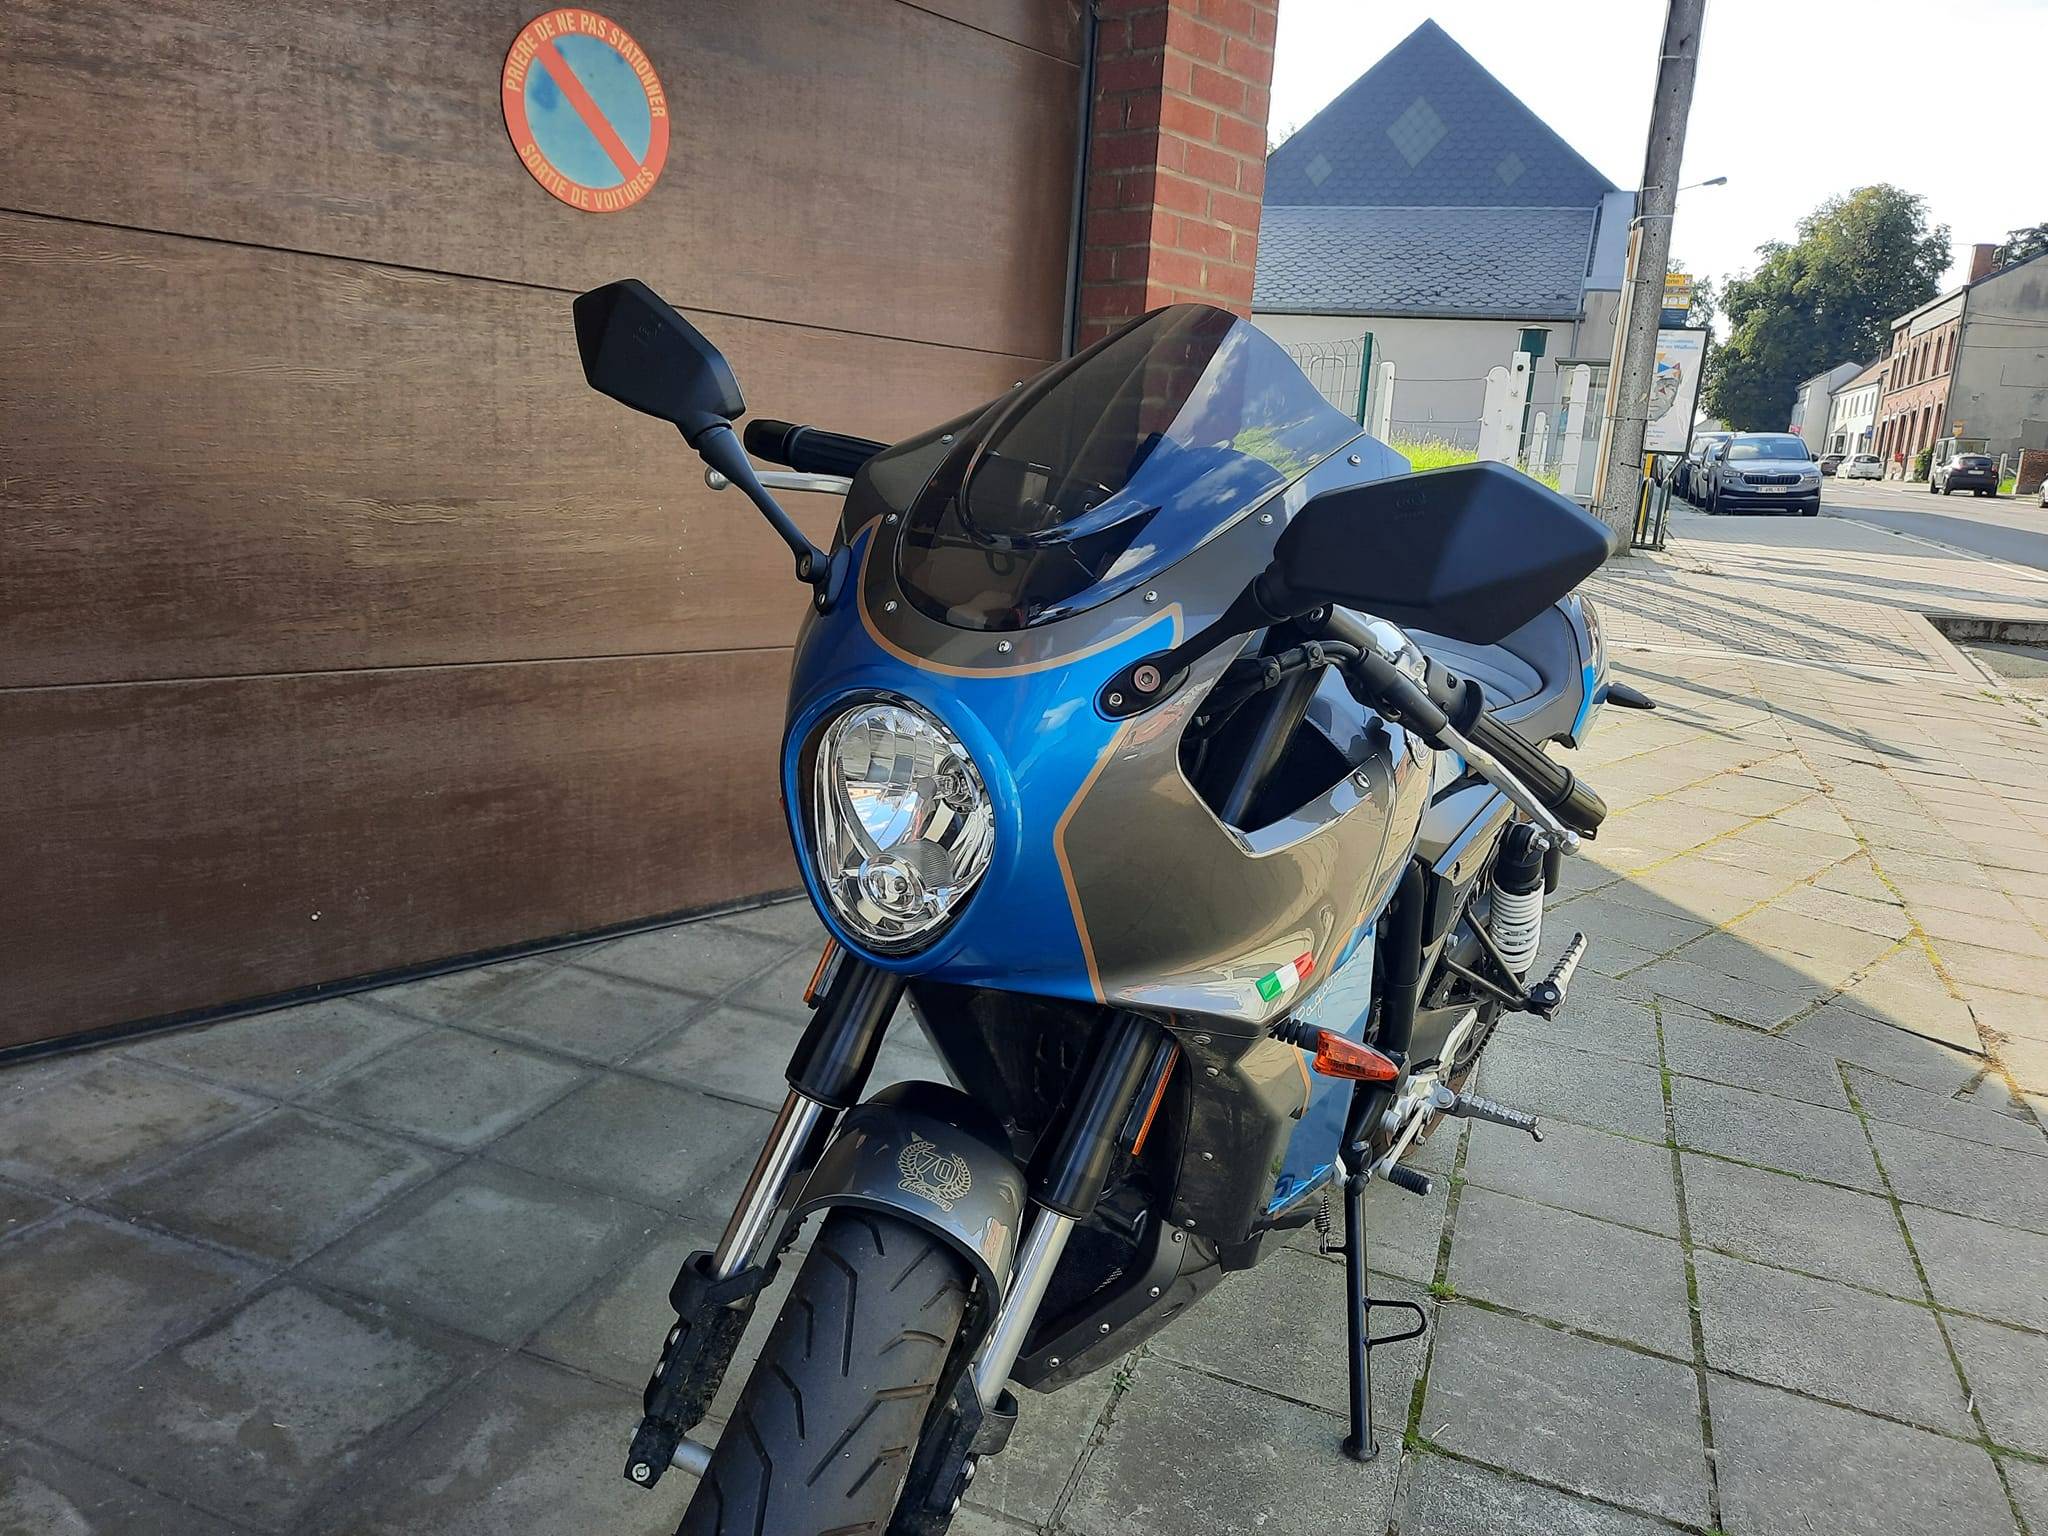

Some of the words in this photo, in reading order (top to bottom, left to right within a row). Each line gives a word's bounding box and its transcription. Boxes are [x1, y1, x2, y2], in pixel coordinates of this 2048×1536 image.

[505, 32, 540, 93] PRIERE
[534, 18, 556, 42] DE
[556, 12, 577, 33] NE
[580, 14, 608, 38] PAS
[608, 28, 666, 118] STATIONNER
[521, 143, 567, 197] SORTIE
[570, 188, 590, 208] DE
[594, 165, 656, 209] VOITURES
[917, 1150, 957, 1184] 70
